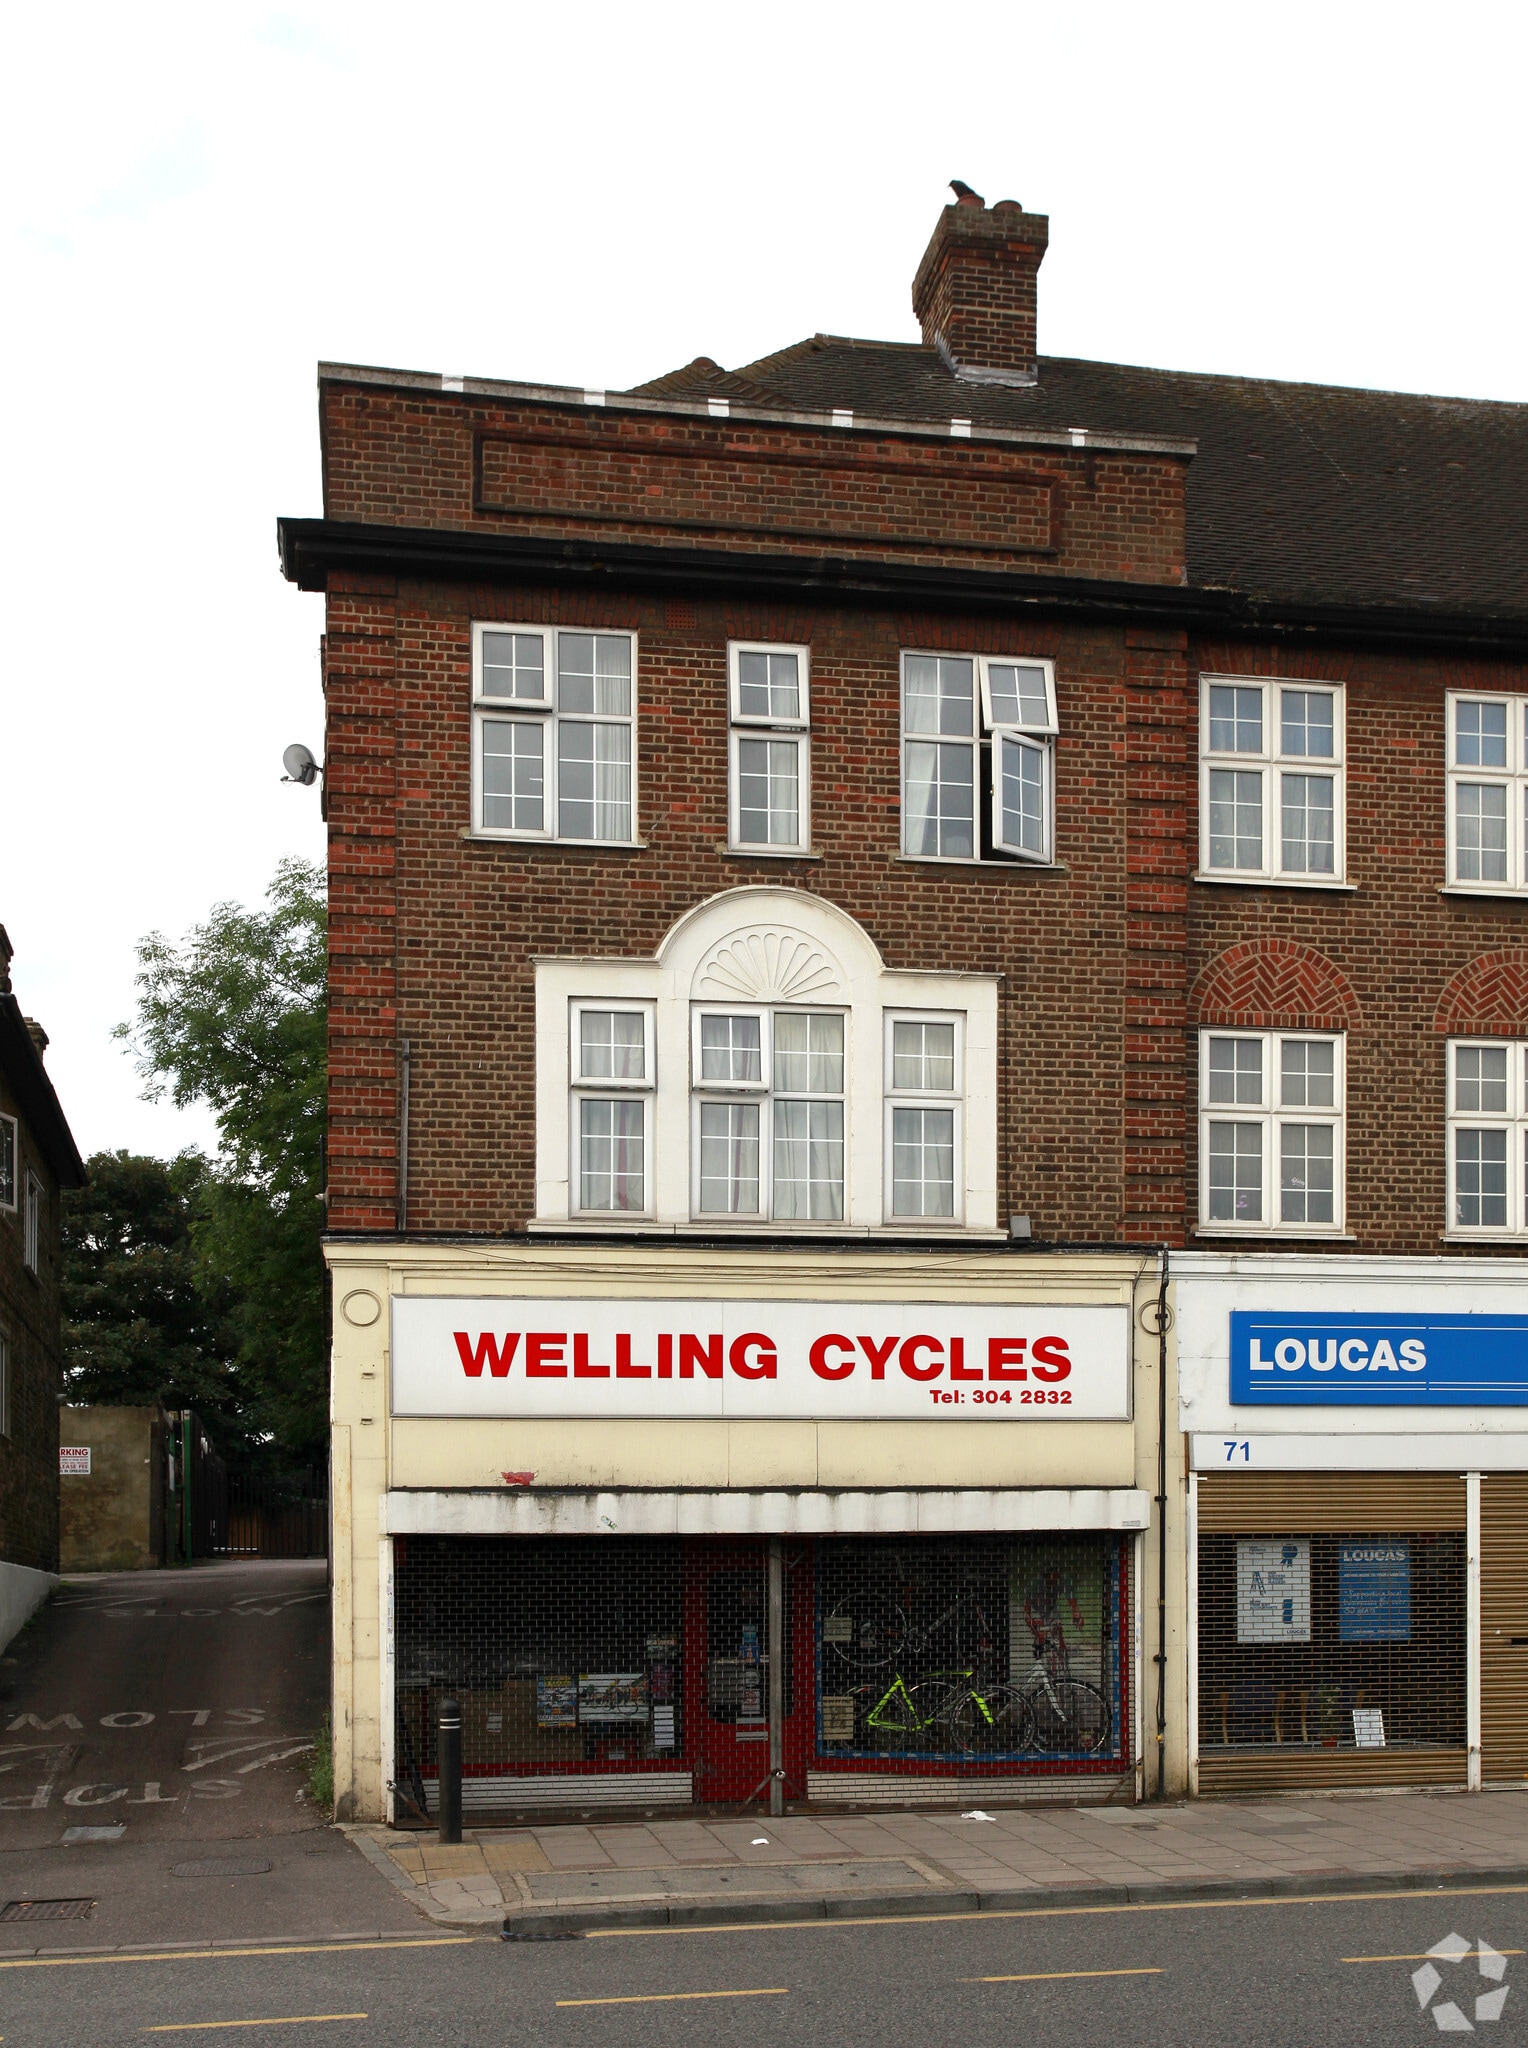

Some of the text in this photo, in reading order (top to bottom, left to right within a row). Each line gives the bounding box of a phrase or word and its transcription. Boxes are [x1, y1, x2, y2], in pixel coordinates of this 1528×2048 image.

[453, 1331, 1072, 1382] WELLING CYCLES
[1249, 1338, 1427, 1372] LOUCAS
[929, 1389, 1073, 1404] Tel: 304 2832
[1223, 1441, 1250, 1462] 71
[1343, 1549, 1406, 1562] LOUCAS
[102, 1607, 283, 1617] SLOW
[5, 1708, 267, 1731] SLOW
